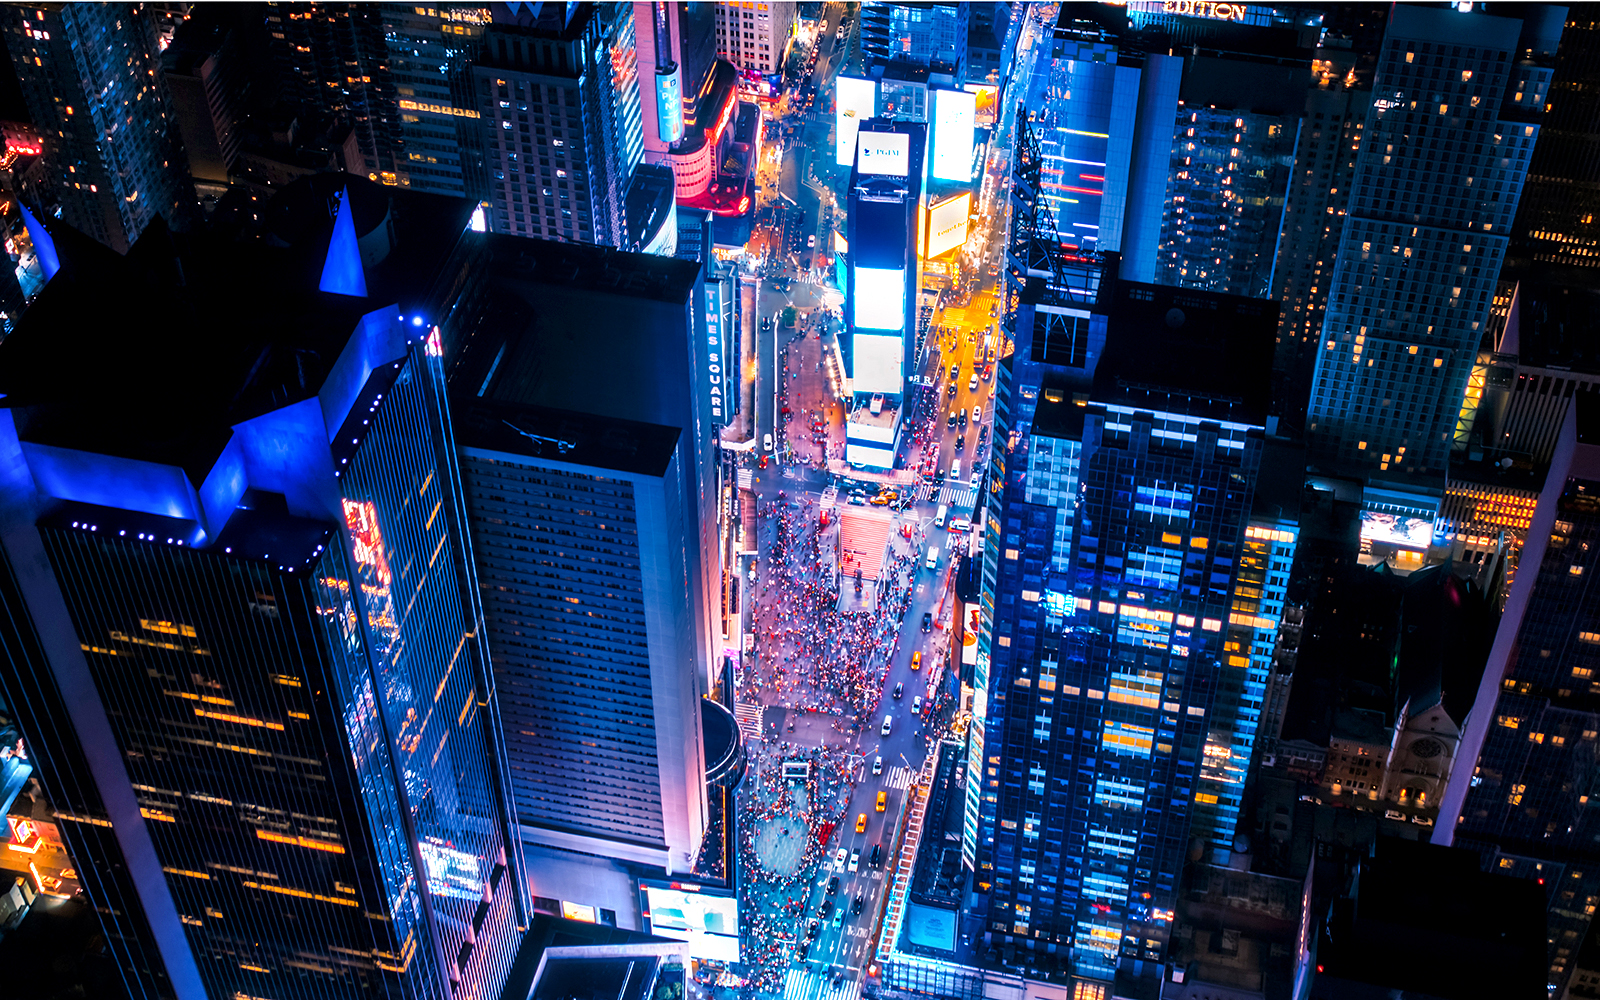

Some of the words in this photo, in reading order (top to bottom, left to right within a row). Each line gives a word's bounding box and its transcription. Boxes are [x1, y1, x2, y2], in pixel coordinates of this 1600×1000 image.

[1162, 1, 1247, 21] EDITION
[705, 290, 719, 346] TIMES
[708, 353, 721, 417] SQUARE
